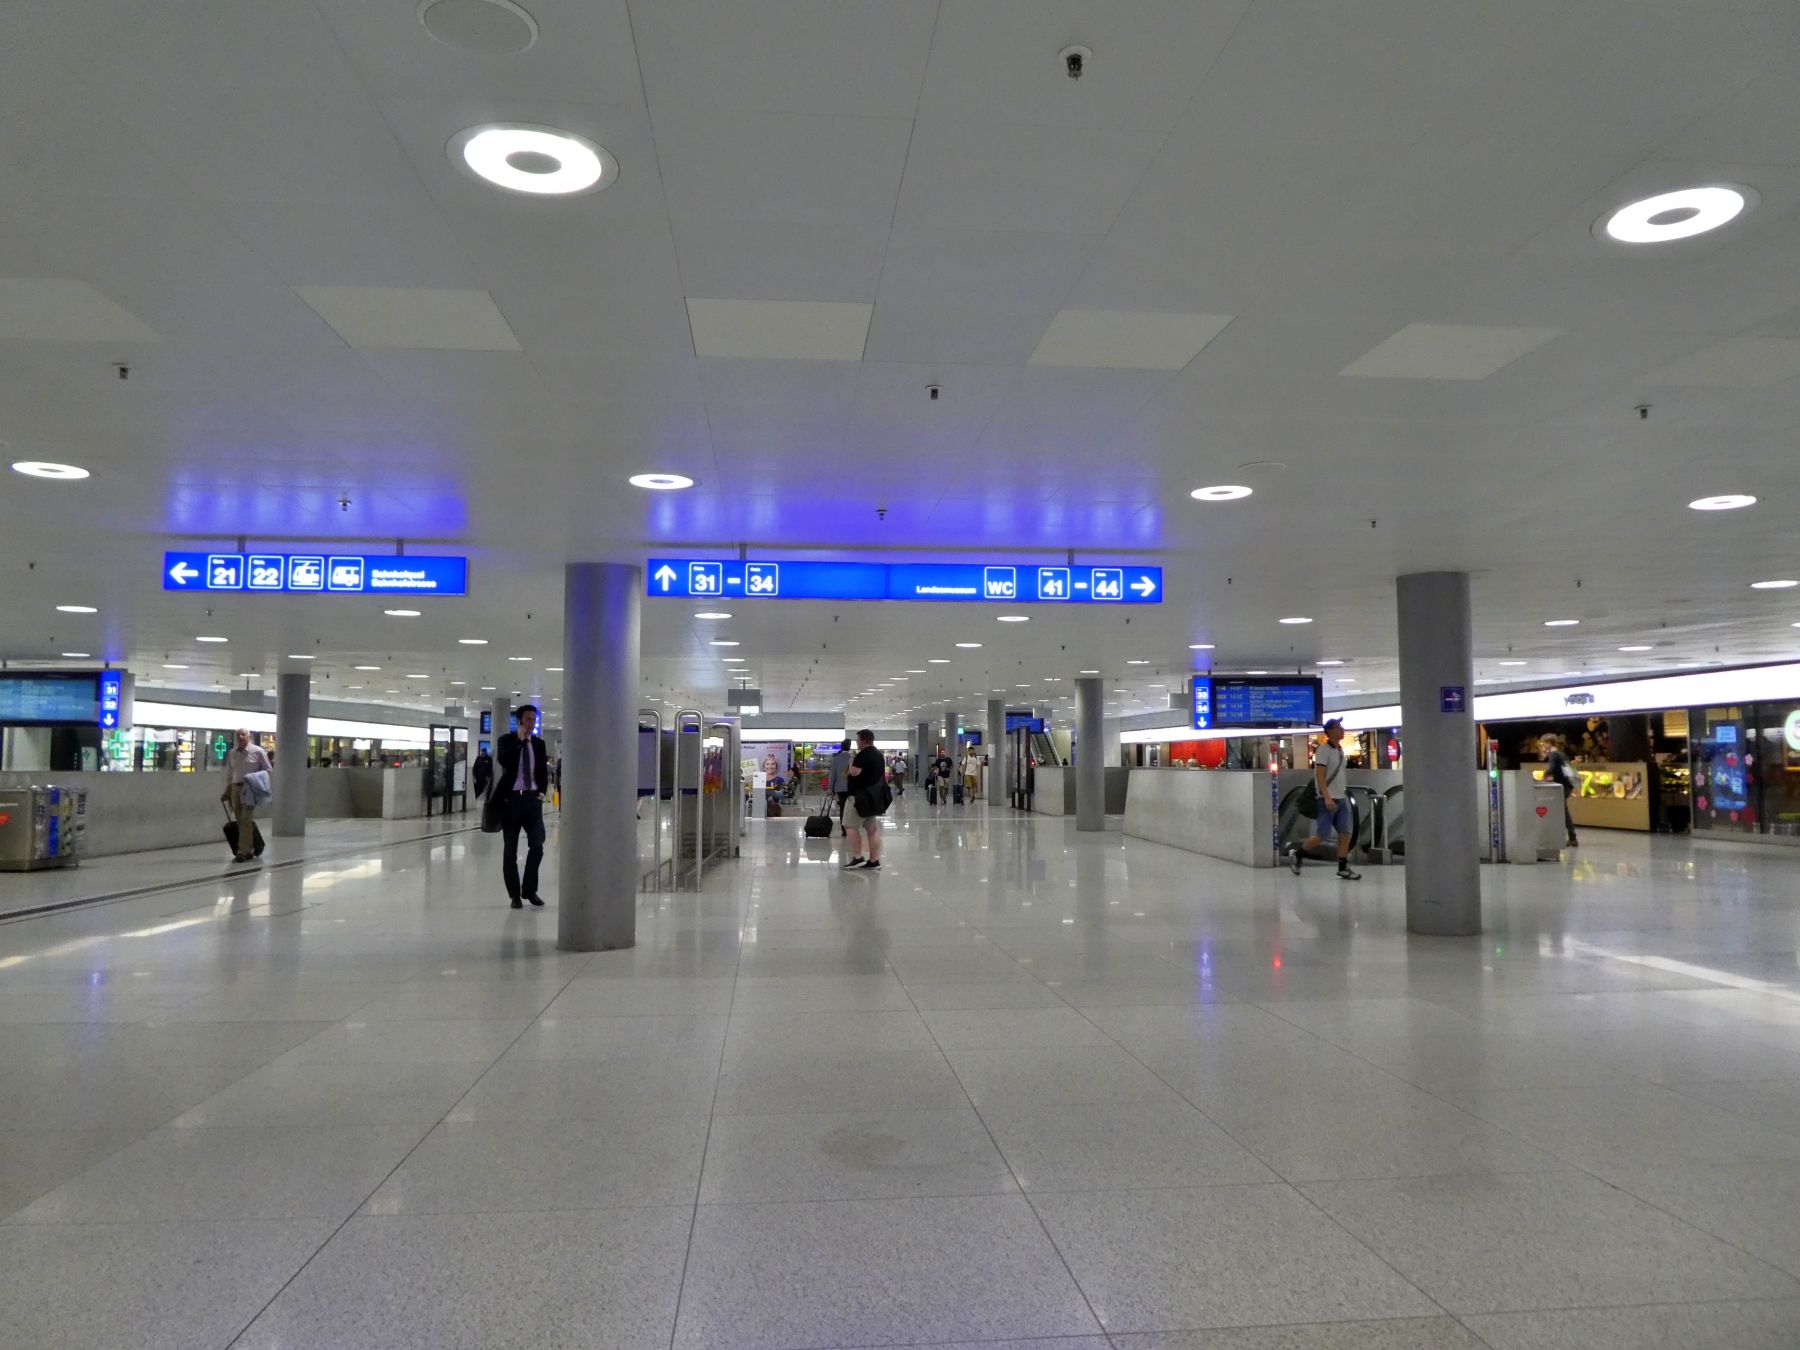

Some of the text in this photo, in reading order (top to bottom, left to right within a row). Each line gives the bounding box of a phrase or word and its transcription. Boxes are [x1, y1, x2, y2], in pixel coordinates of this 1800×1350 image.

[214, 567, 278, 586] 21 22
[695, 574, 715, 591] 31
[750, 575, 773, 592] 34
[987, 581, 1014, 596] WC
[1043, 580, 1063, 596] 41
[1096, 580, 1119, 597] 44
[1197, 704, 1207, 712] 34
